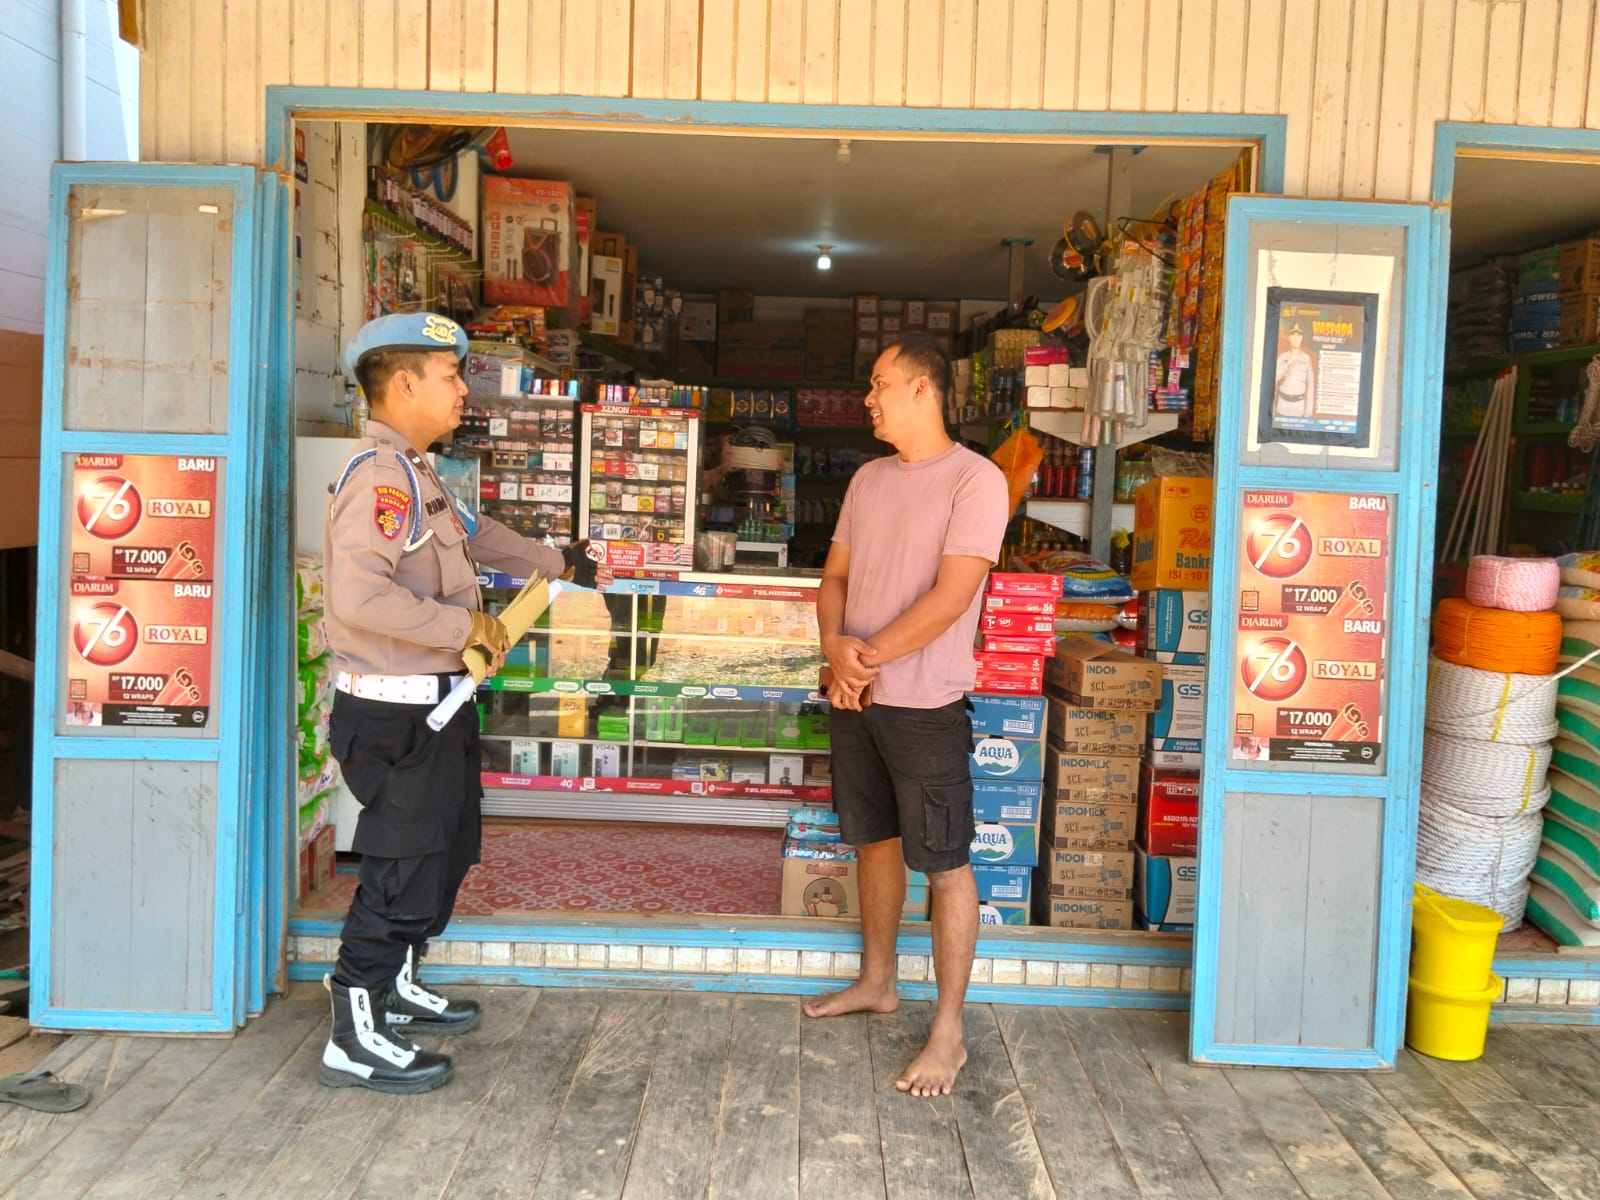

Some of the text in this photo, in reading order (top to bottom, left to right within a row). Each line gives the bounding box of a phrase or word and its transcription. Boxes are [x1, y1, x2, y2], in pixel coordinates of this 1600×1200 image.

[1312, 320, 1353, 338] WASPADA
[601, 405, 630, 414] XENON
[77, 457, 215, 472] DJARUM BARU
[85, 480, 132, 531] 76
[152, 502, 206, 515] ROYAL
[1247, 495, 1386, 510] DJARUM BARU
[1255, 518, 1303, 569] 76
[1323, 540, 1377, 554] ROYAL
[124, 549, 167, 564] 17.000
[74, 583, 211, 598] DJARUM BARU
[693, 585, 706, 595] 4G
[1295, 588, 1337, 603] 17.000
[81, 606, 128, 658] 76
[1241, 617, 1381, 633] DJARUM BARU
[149, 628, 203, 641] ROYAL
[1249, 641, 1297, 692] 76
[1318, 663, 1372, 677] ROYAL
[121, 676, 163, 691] 17.000
[1177, 683, 1202, 696] GS
[1069, 710, 1116, 720] INDOMILK
[1289, 711, 1332, 726] 17.000
[980, 746, 1013, 760] AQUA
[1061, 758, 1110, 768] INDOMILK
[560, 779, 574, 788] 4G
[975, 833, 1007, 846] AQUA
